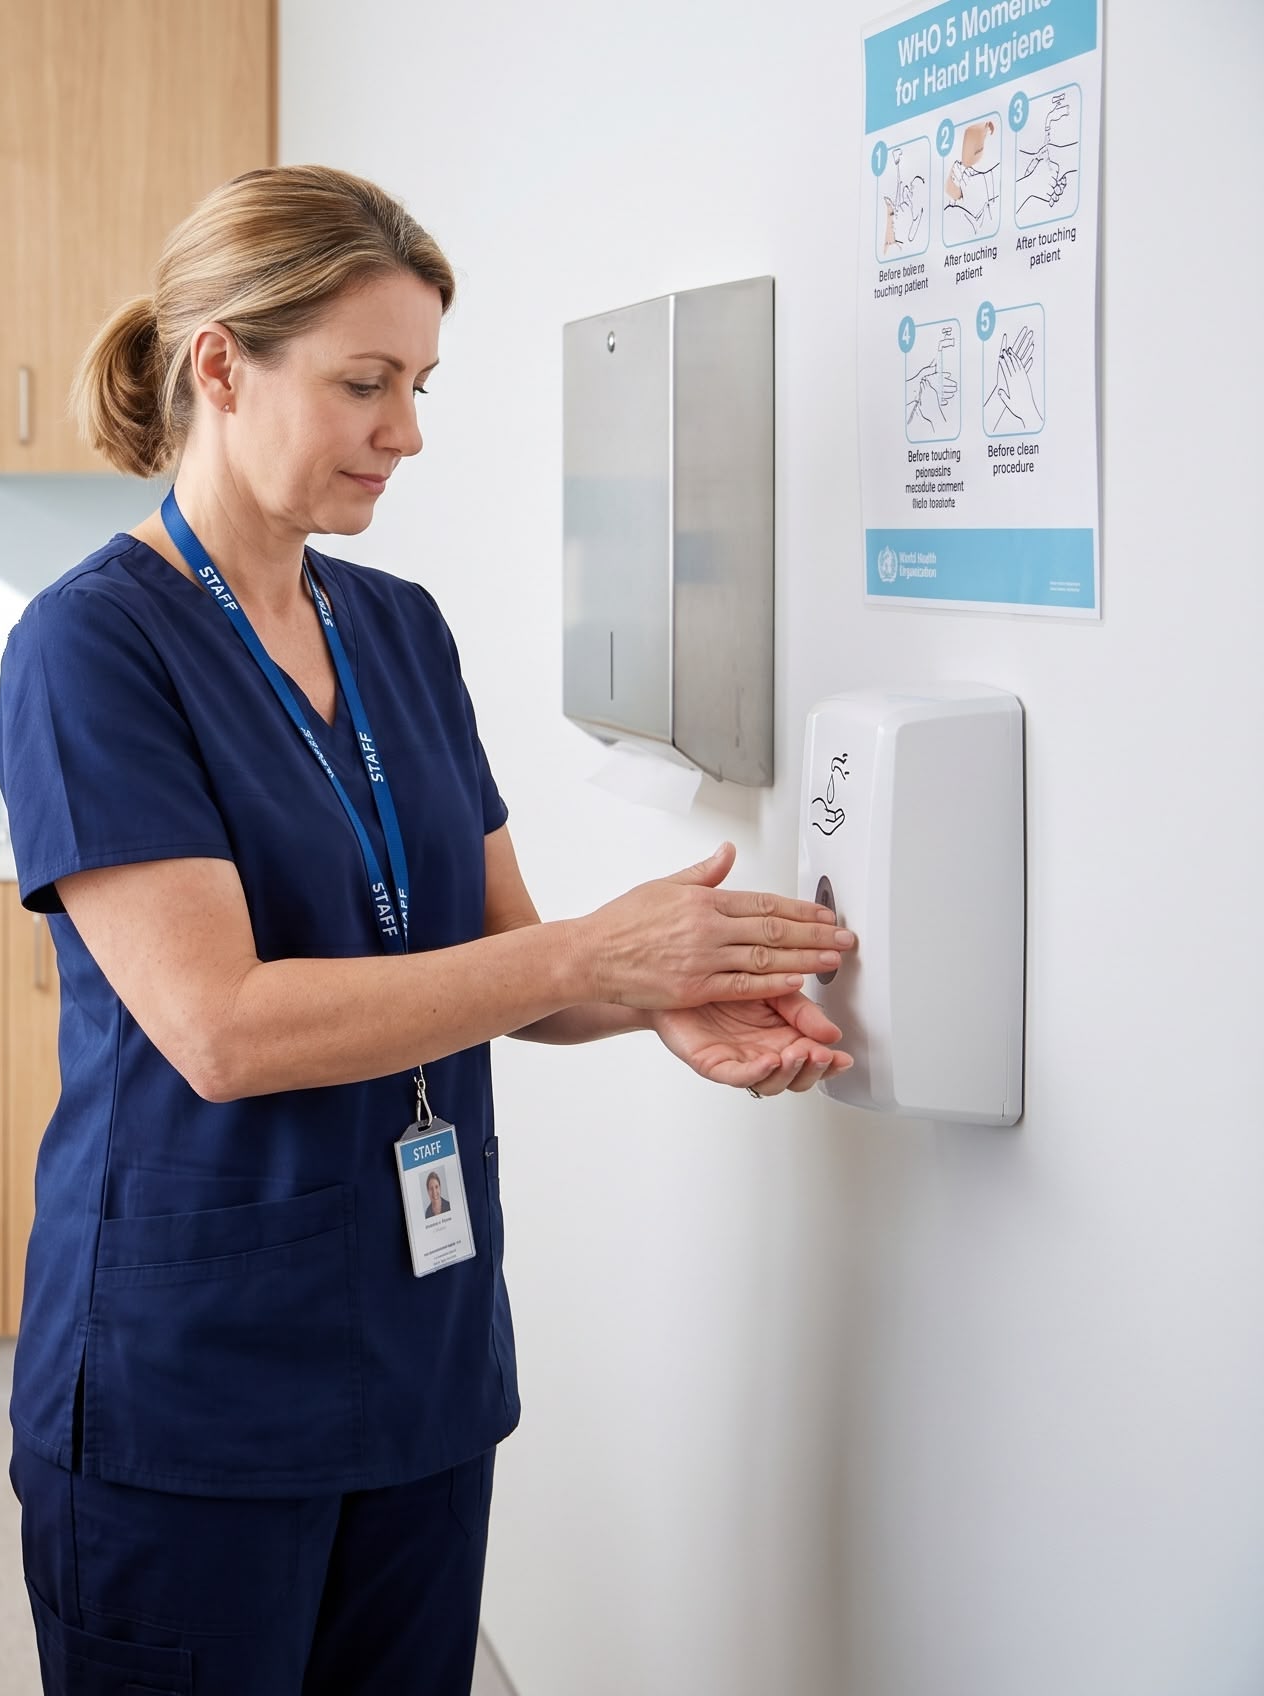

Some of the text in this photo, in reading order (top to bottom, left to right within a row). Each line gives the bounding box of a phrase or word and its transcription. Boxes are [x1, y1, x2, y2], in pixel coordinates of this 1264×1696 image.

[897, 24, 941, 67] WHO
[946, 16, 957, 47] 5
[896, 24, 1055, 106] for Hand Hygiene
[1013, 100, 1024, 124] 3
[940, 126, 950, 150] 2
[875, 147, 882, 170] 1
[1016, 226, 1077, 251] After touching
[944, 245, 998, 268] After touching
[1029, 248, 1061, 269] patient
[879, 268, 901, 283] Before
[904, 277, 929, 295] patient
[955, 266, 983, 285] patient
[981, 307, 990, 332] 5
[902, 322, 911, 344] 4
[907, 448, 961, 463] Before touching
[987, 442, 1039, 458] Before clean
[993, 460, 1034, 477] procedure
[198, 566, 239, 610] STAFF
[358, 731, 384, 783] STAFF
[372, 882, 399, 936] STAFF
[413, 1140, 442, 1161] STAFF
